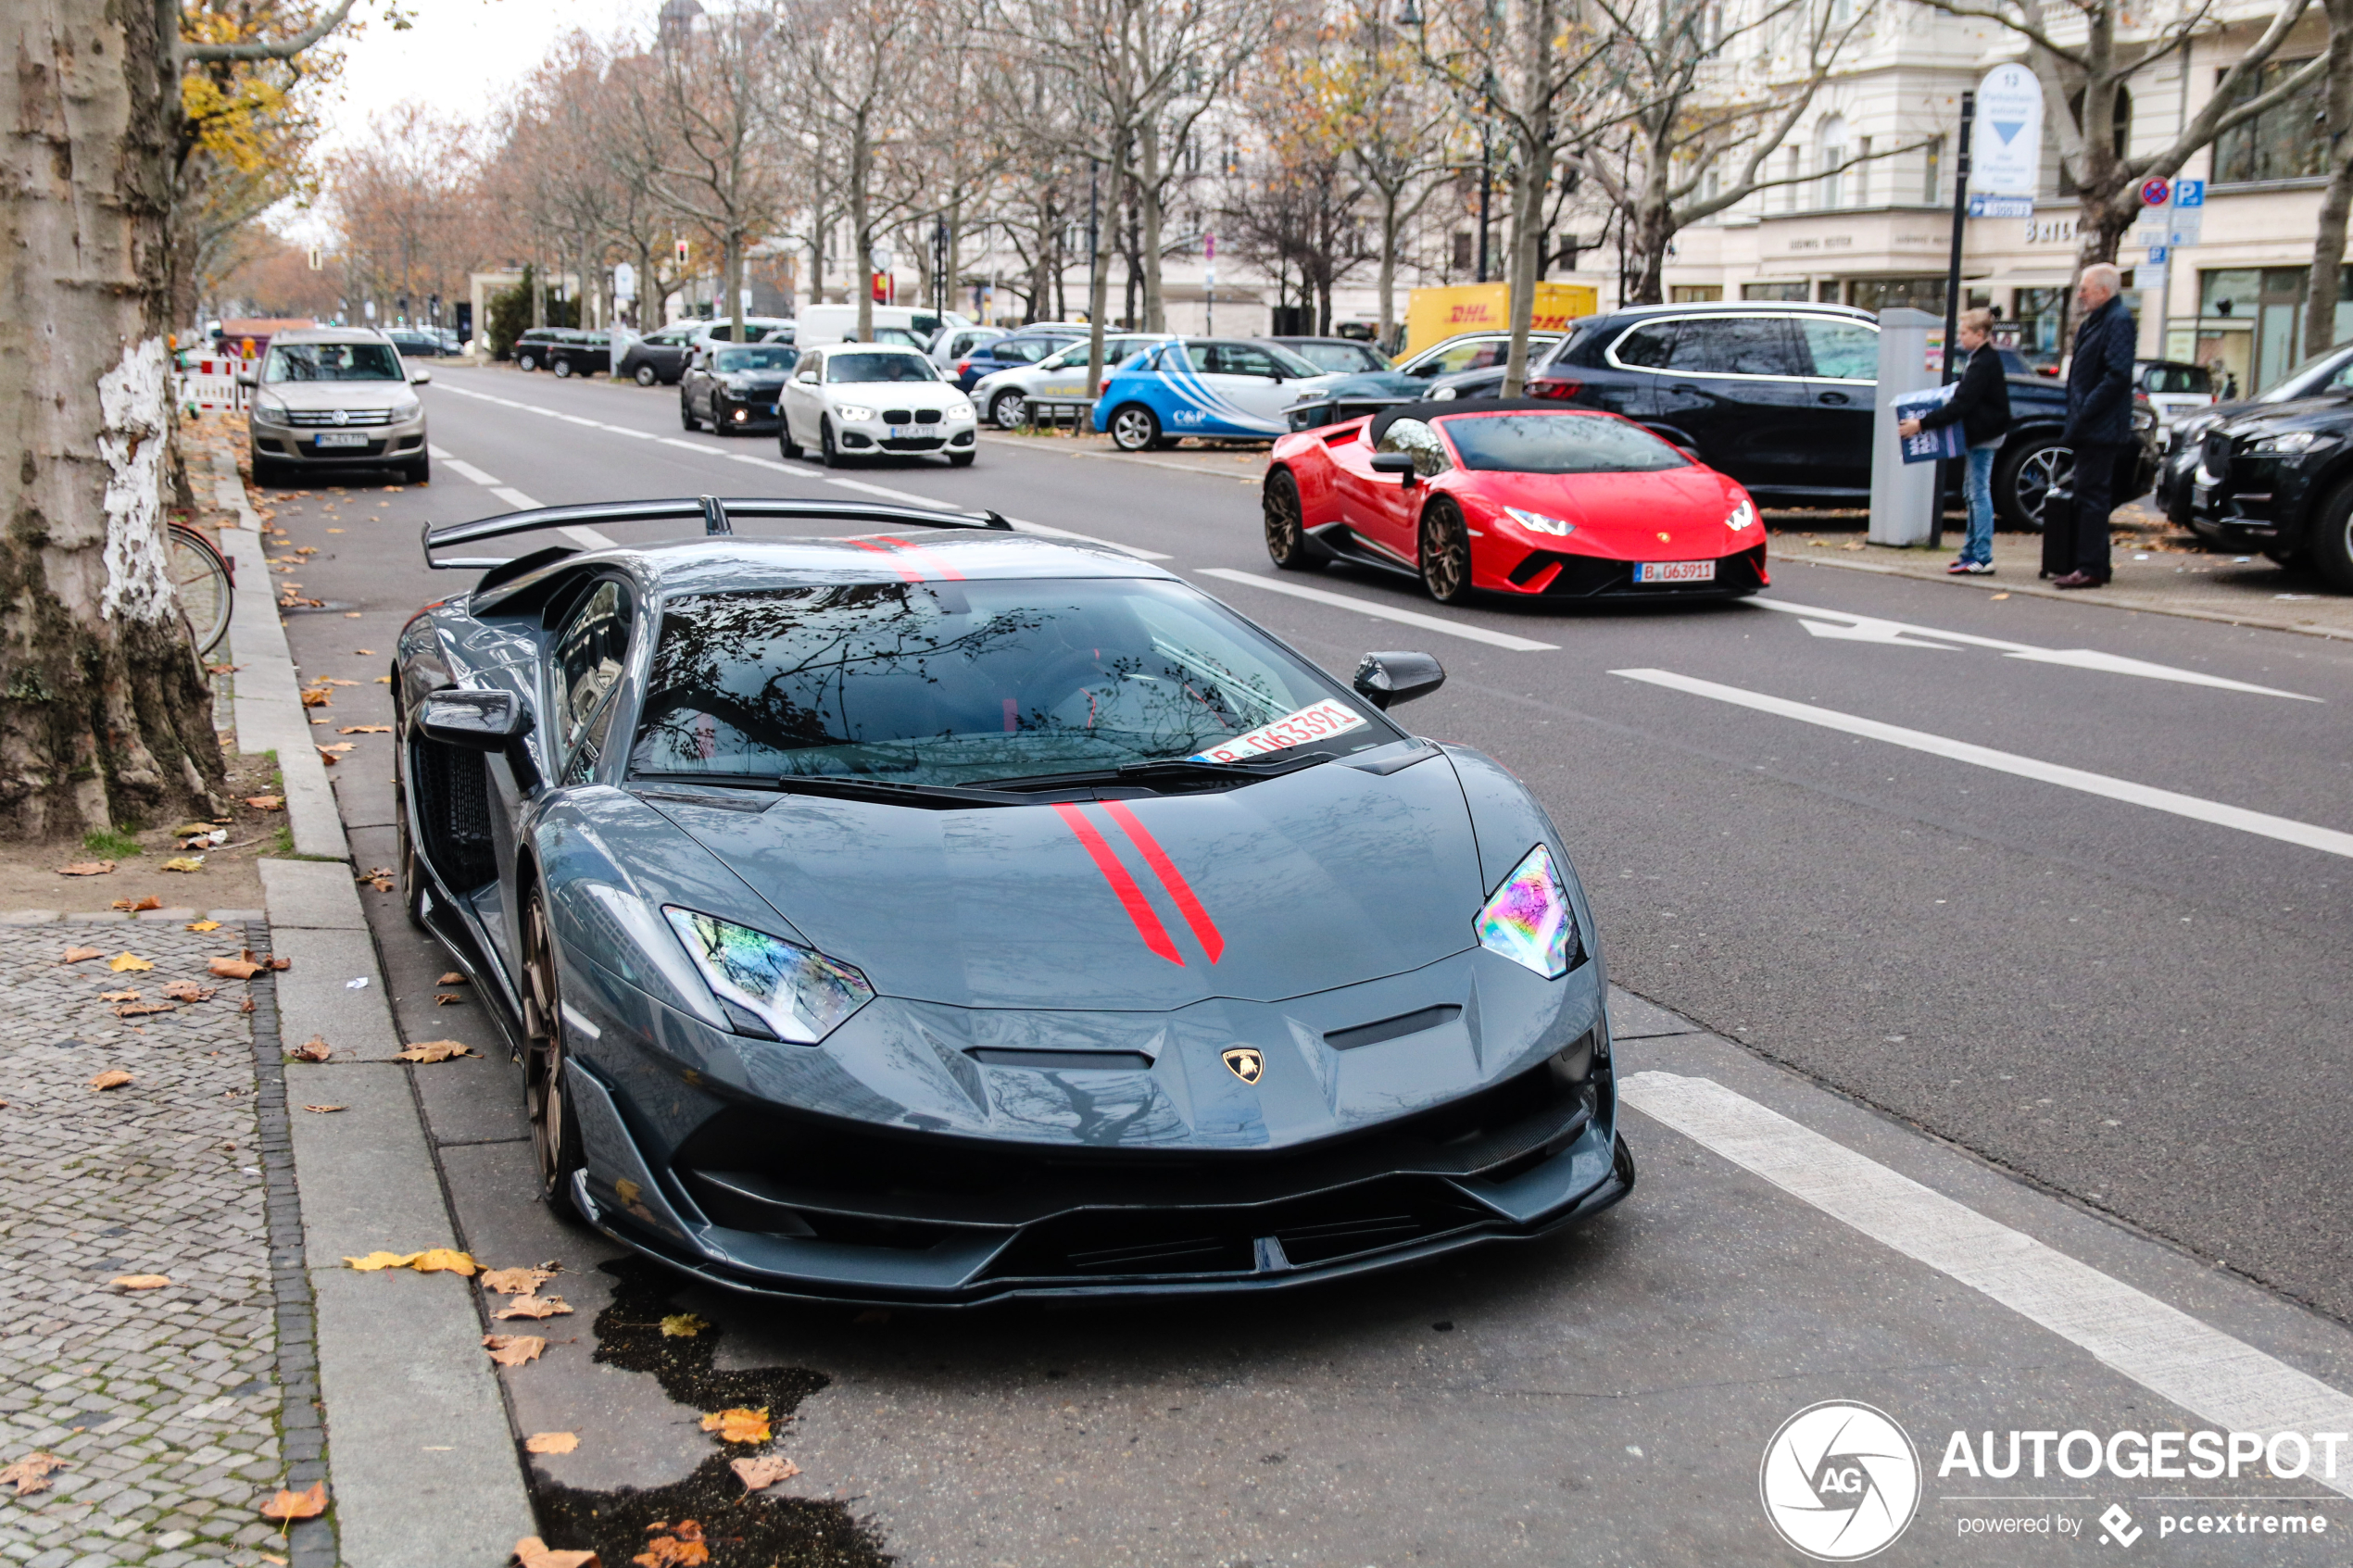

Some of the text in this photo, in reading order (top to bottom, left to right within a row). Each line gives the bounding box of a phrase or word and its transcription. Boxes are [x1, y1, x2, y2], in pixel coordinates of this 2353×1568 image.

[1451, 304, 1488, 322] DHL
[1173, 409, 1206, 422] C&P
[1644, 563, 1710, 579] B 063911
